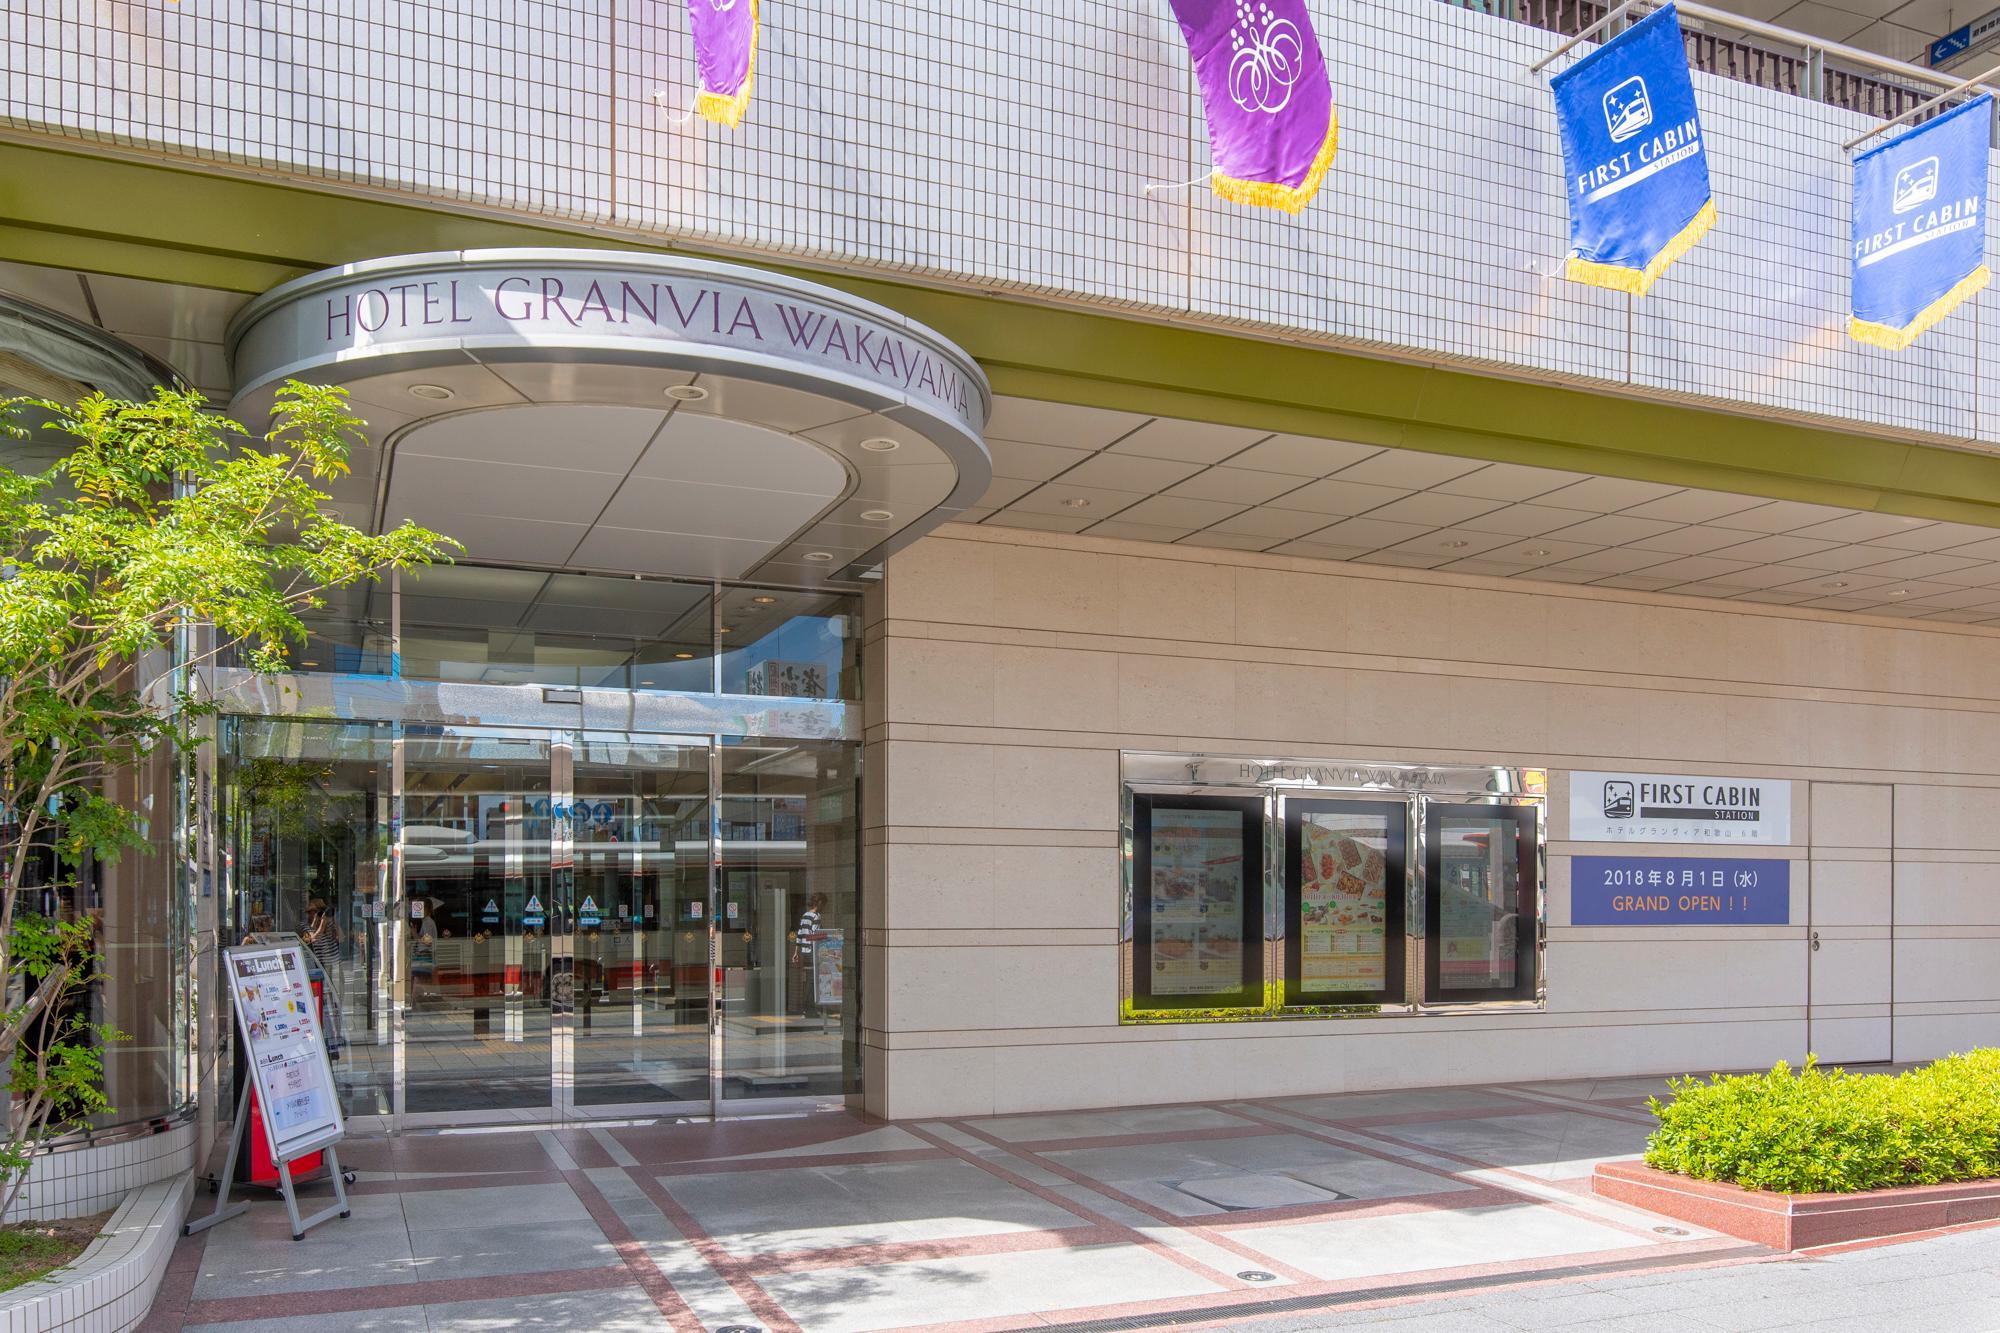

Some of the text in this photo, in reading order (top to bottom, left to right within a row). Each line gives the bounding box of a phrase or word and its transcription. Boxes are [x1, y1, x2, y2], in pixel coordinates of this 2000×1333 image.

[1578, 118, 1698, 194] FIRST CABIN
[1653, 145, 1696, 171] STATION
[1855, 196, 1978, 259] FIRST CABIN
[1923, 219, 1970, 240] STATION
[325, 277, 971, 421] HOTEL GRANVIA WAKAYAMA
[1292, 767, 1361, 783] GRANVIA
[1640, 783, 1760, 807] FIRST CABIN
[1714, 810, 1754, 820] STATION
[1612, 896, 1670, 911] GRAND
[1678, 896, 1721, 911] OPEN
[254, 957, 283, 973] Lunch
[267, 1053, 284, 1063] Lunch
